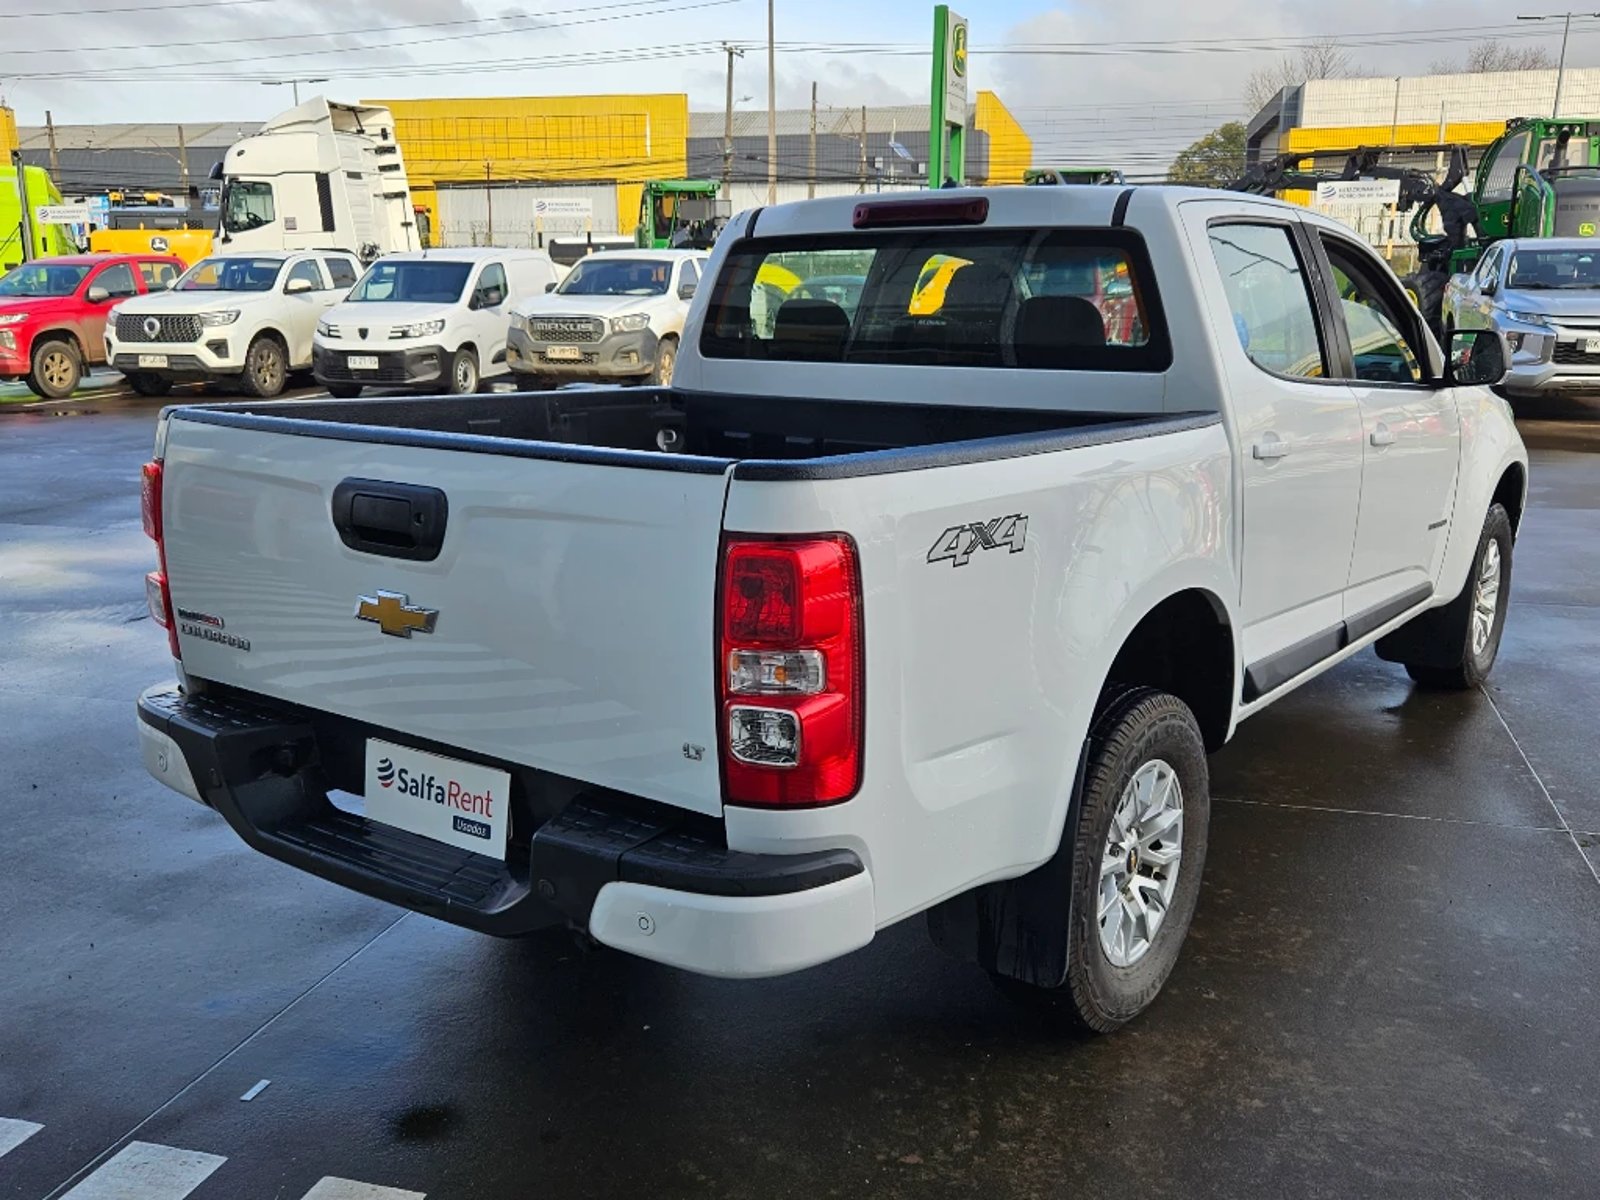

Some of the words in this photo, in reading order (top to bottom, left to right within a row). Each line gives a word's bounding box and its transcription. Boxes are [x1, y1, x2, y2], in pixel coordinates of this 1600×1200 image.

[534, 322, 593, 331] MAXUS
[397, 767, 493, 818] SalfaRent
[456, 818, 487, 837] Usados
